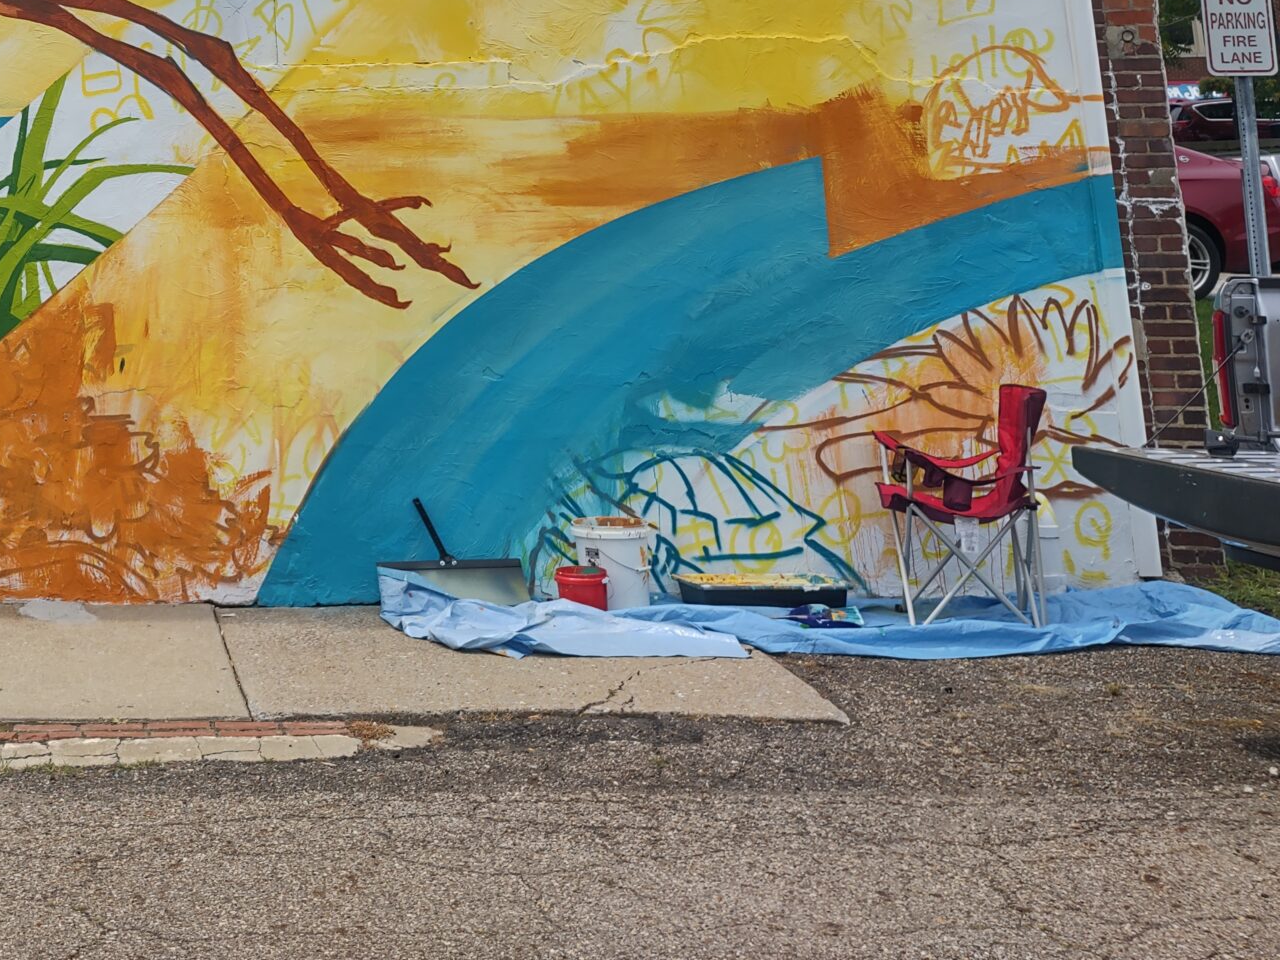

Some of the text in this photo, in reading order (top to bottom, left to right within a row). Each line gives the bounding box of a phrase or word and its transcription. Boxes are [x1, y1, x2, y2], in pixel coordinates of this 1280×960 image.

[1210, 11, 1266, 30] PARKING
[1222, 35, 1258, 48] FIRE
[1220, 51, 1263, 64] LANE
